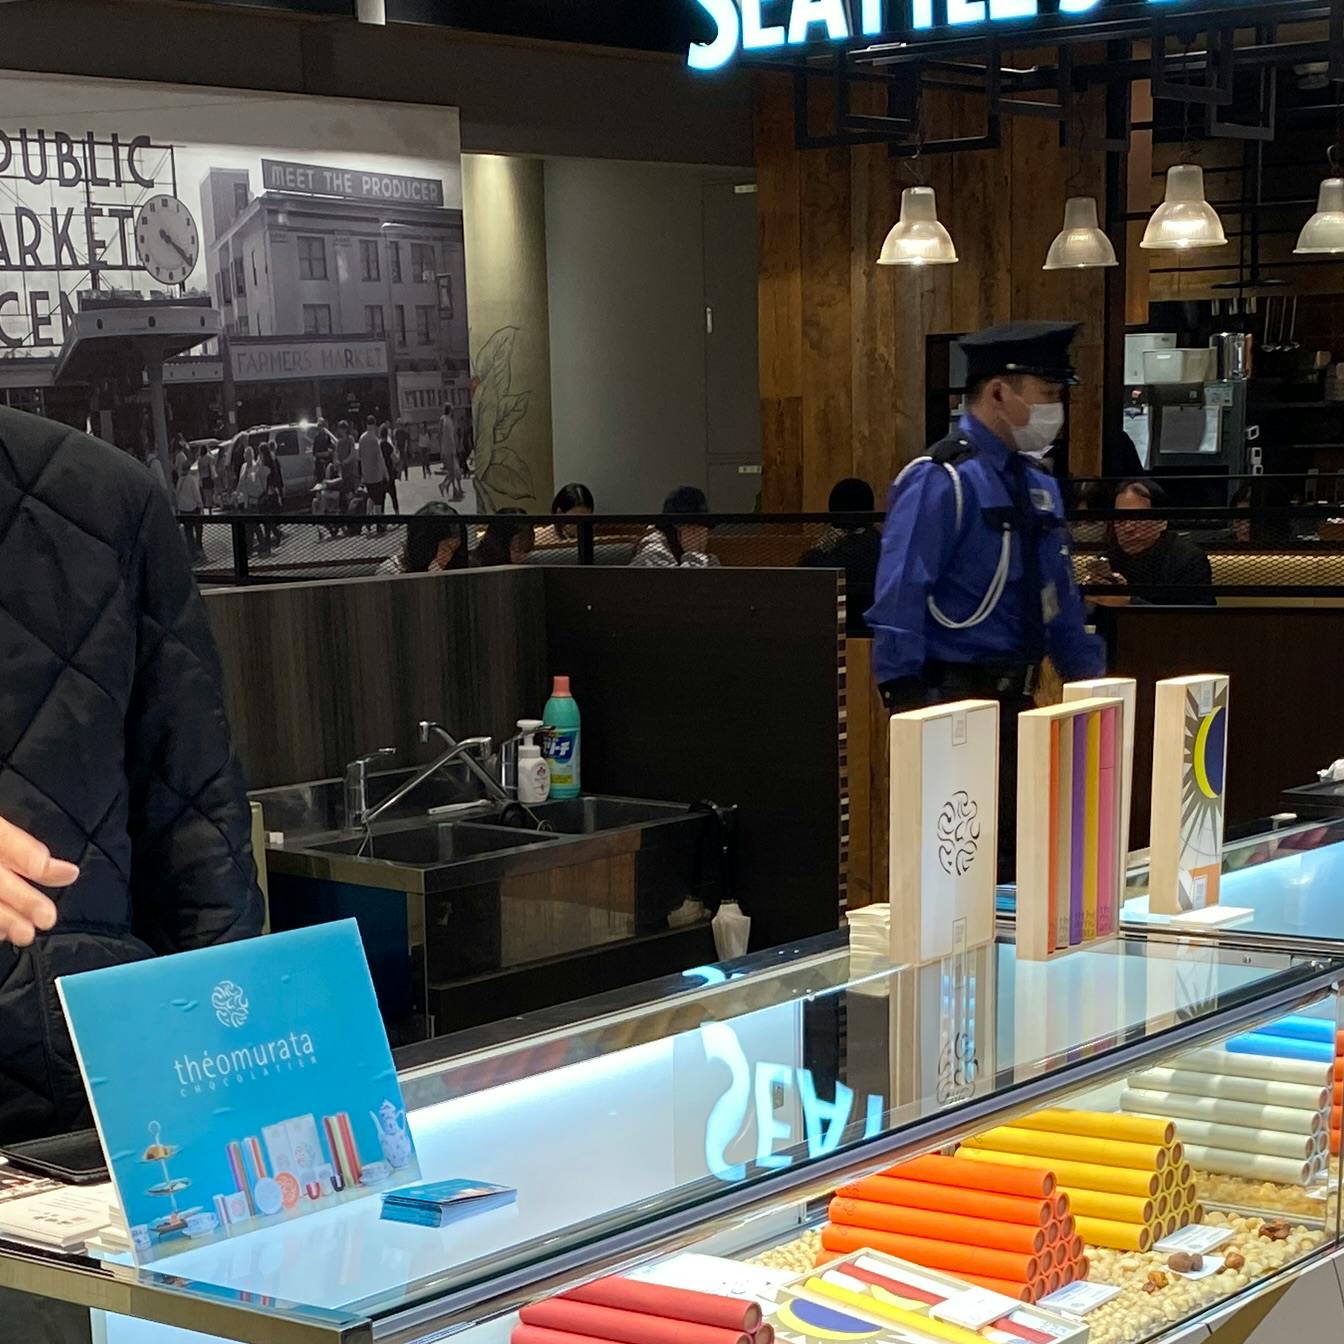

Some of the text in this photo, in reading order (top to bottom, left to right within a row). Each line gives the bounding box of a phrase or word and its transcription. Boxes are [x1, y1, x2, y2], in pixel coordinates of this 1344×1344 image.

[271, 163, 440, 202] MEET THE PRODUCER
[236, 345, 385, 375] FARMERS MARKET
[173, 1031, 315, 1086] théomurata
[180, 1055, 318, 1097] CHOCOLATIER
